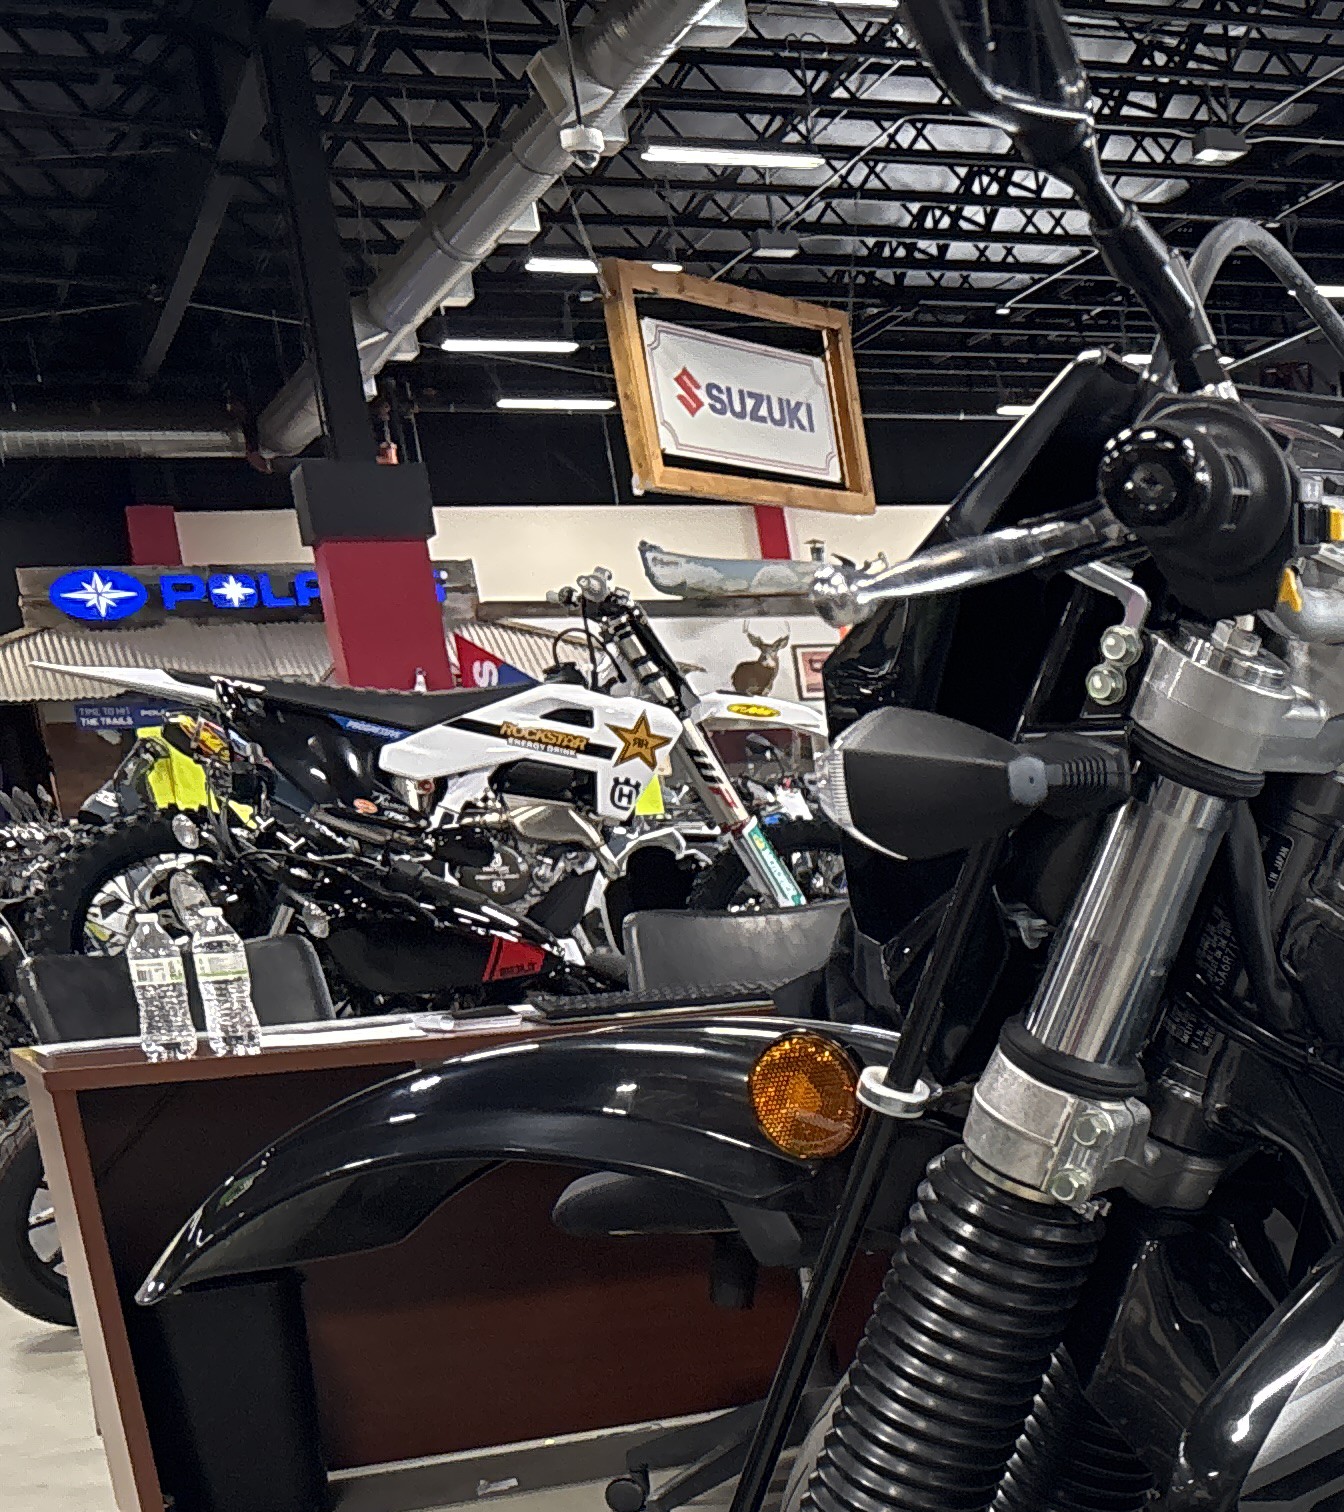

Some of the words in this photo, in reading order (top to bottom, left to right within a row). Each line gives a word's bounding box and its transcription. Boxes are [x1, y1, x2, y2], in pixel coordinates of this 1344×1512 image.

[705, 381, 816, 433] SUZUKI
[500, 721, 591, 750] ROCKSTAR
[507, 737, 545, 751] ENERGY
[546, 744, 577, 757] DRINK
